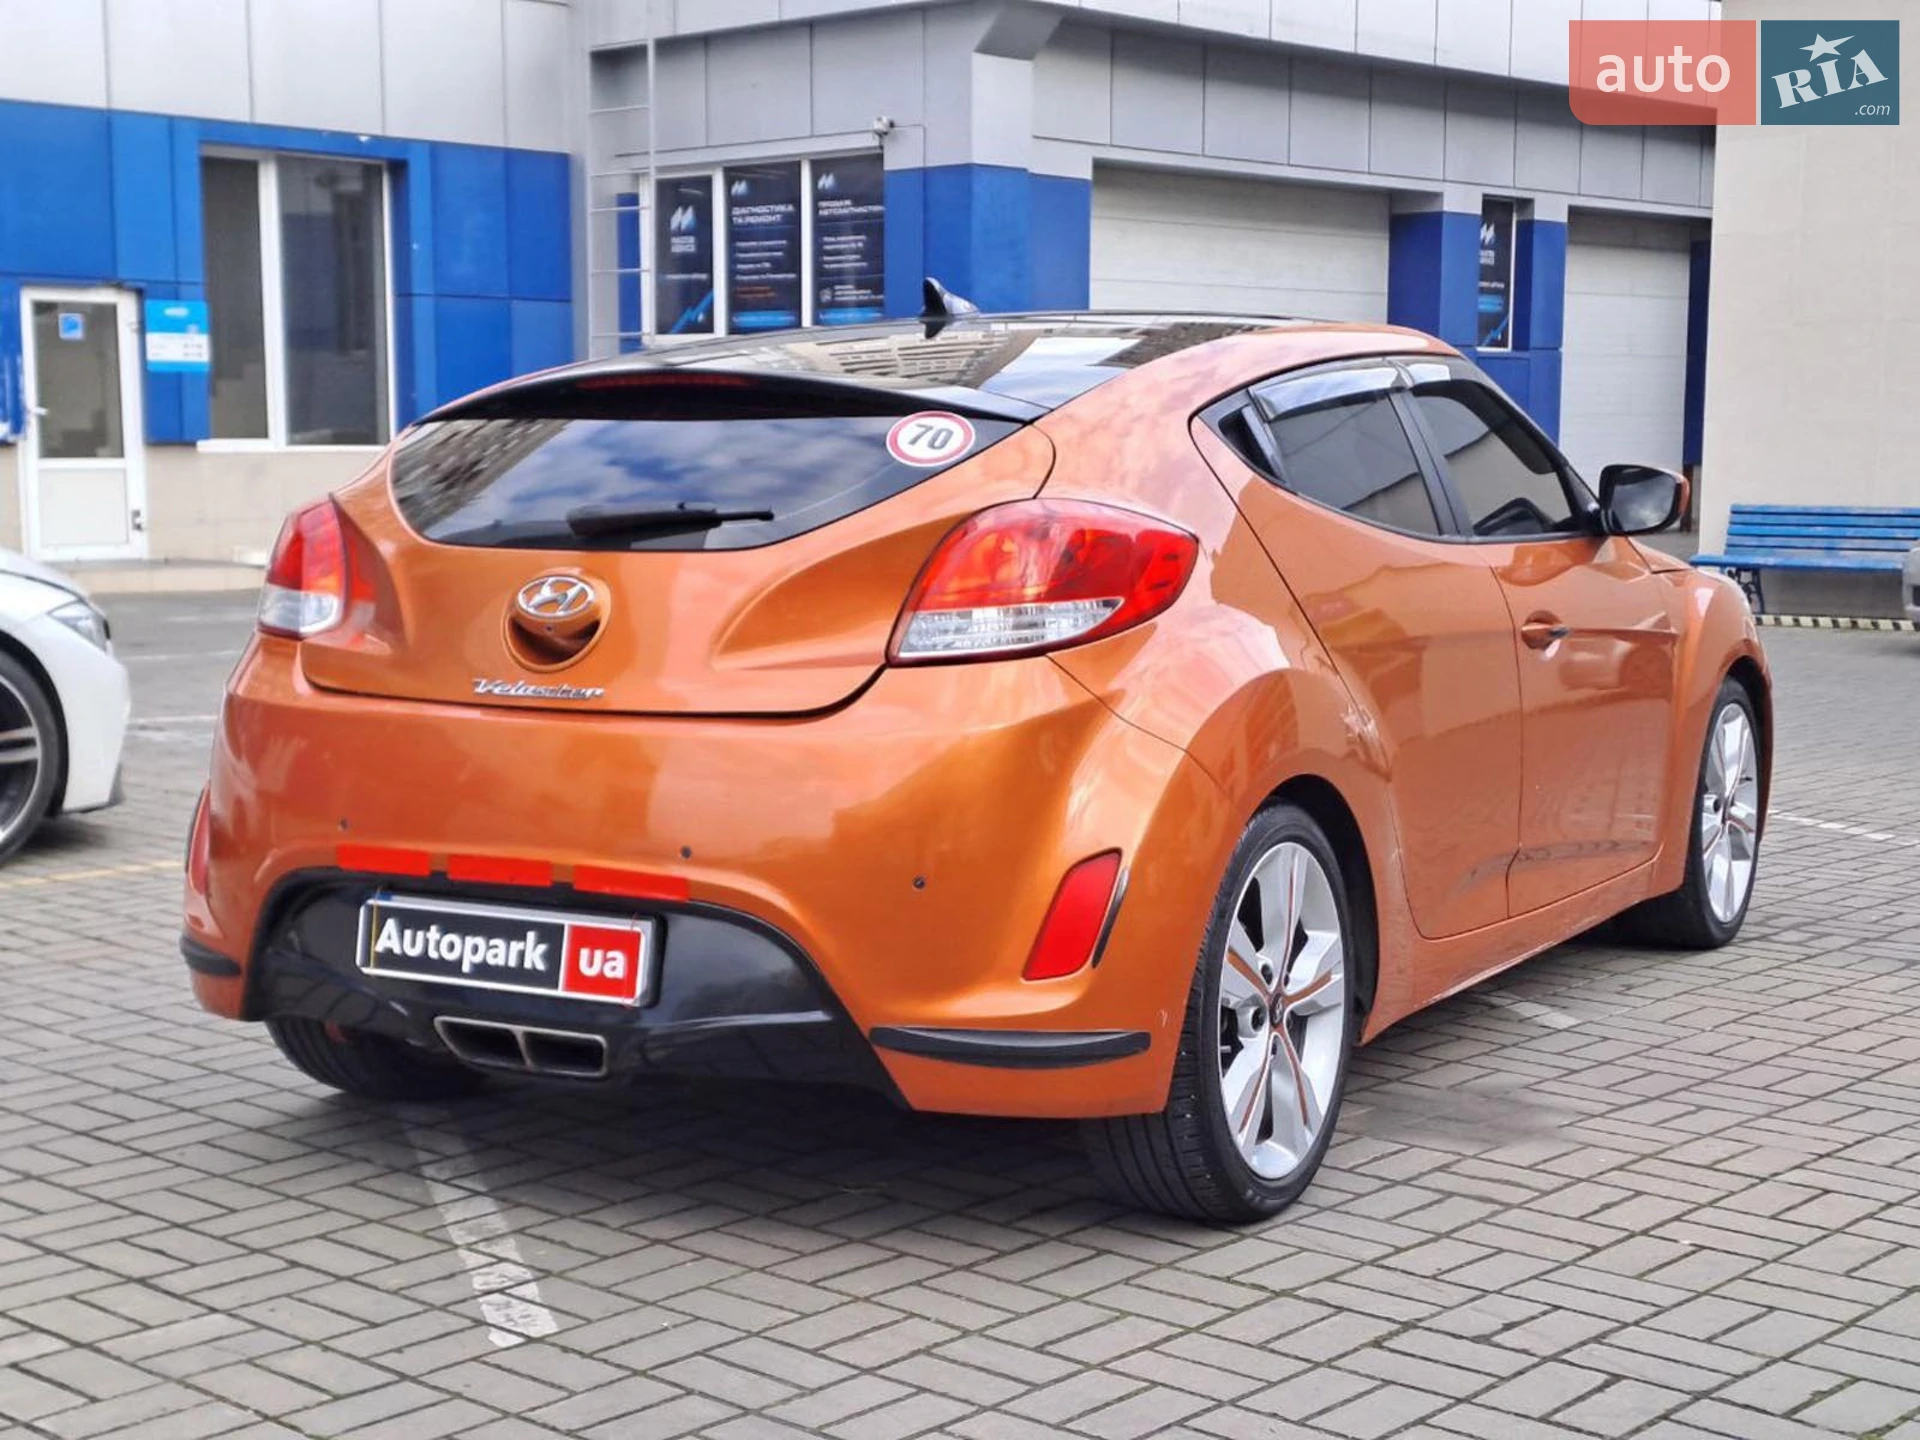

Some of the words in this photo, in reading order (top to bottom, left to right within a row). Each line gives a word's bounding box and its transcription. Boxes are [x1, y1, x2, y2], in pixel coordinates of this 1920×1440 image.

[907, 423, 954, 450] 70
[374, 917, 550, 974] Autopark
[578, 947, 626, 980] ua
